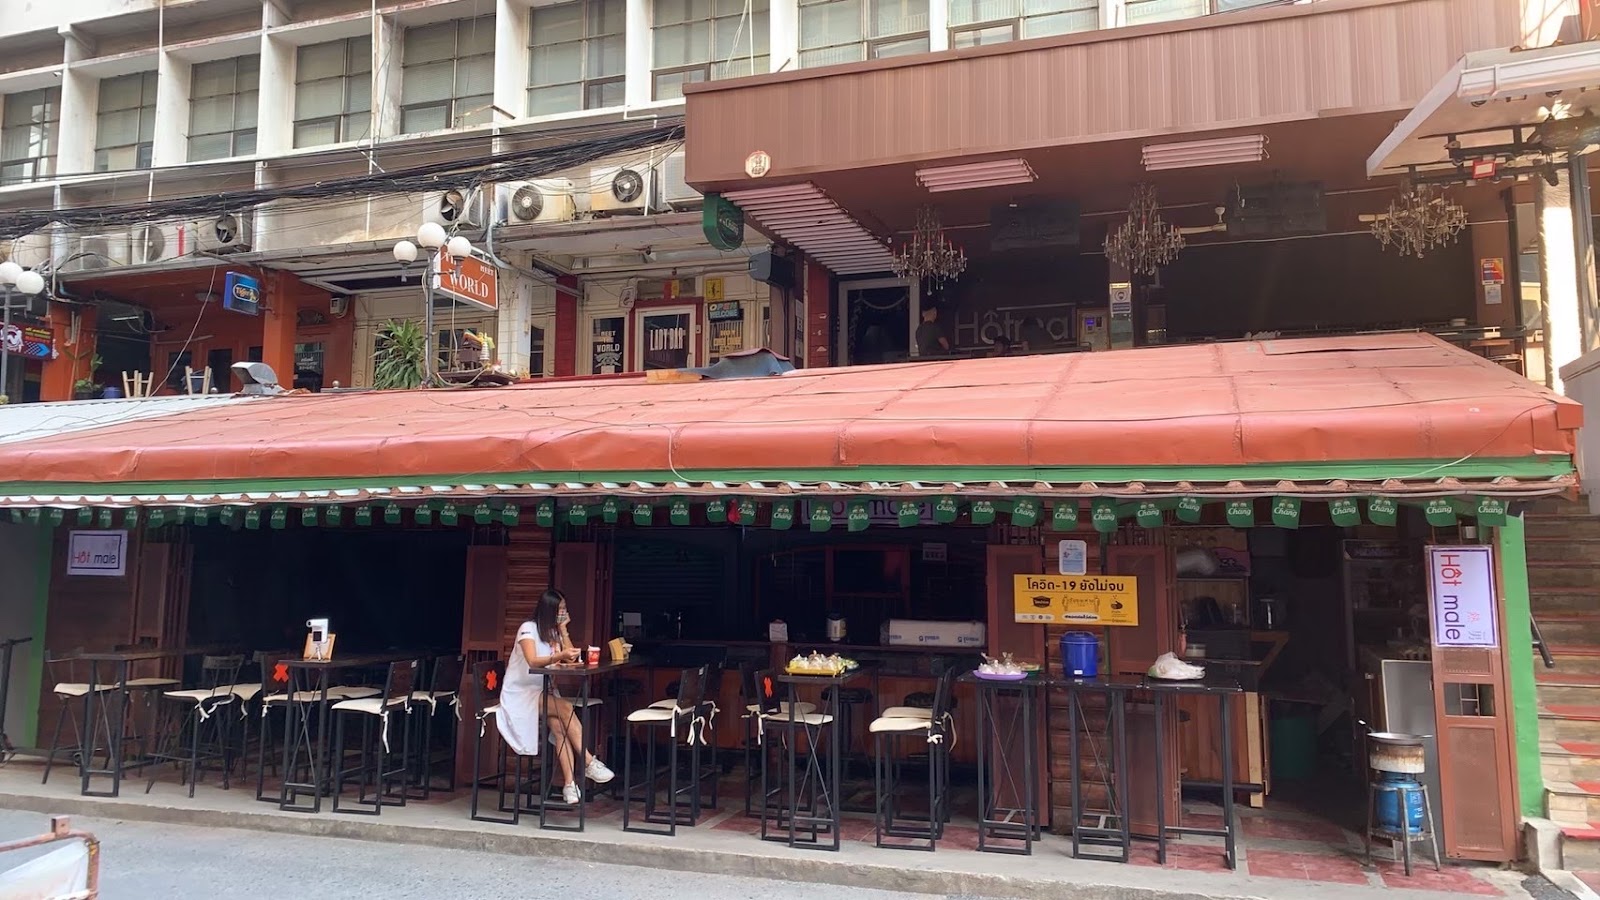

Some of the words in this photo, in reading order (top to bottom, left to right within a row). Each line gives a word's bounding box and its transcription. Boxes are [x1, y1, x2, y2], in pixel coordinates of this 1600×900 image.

[449, 268, 489, 298] WORLD
[709, 302, 737, 312] OPEN
[709, 309, 738, 319] WELCOME
[650, 328, 668, 351] LADY
[669, 327, 683, 350] BAR
[596, 343, 621, 353] WORLD
[738, 506, 755, 516] Chang
[936, 504, 956, 512] Chang
[973, 505, 994, 514] Chang
[1014, 506, 1036, 518] Chang
[1138, 508, 1160, 516] Chang
[1178, 502, 1200, 512] Chang
[1228, 508, 1252, 516] Chang
[1332, 505, 1356, 516] Chang
[1370, 504, 1395, 514] Chang
[1426, 505, 1452, 514] Chang
[1478, 505, 1504, 514] Chang
[440, 510, 457, 518] Chang
[502, 510, 518, 518] Chang
[537, 510, 552, 518] Chang
[773, 512, 792, 520] Chang
[1054, 512, 1076, 521] Chang
[1093, 512, 1115, 521] Chang
[1273, 507, 1298, 518] Chang
[94, 552, 116, 564] male
[1027, 577, 1076, 591] โควิด-19
[1080, 578, 1125, 592] ยังไม่จบ
[1443, 595, 1465, 640] male
